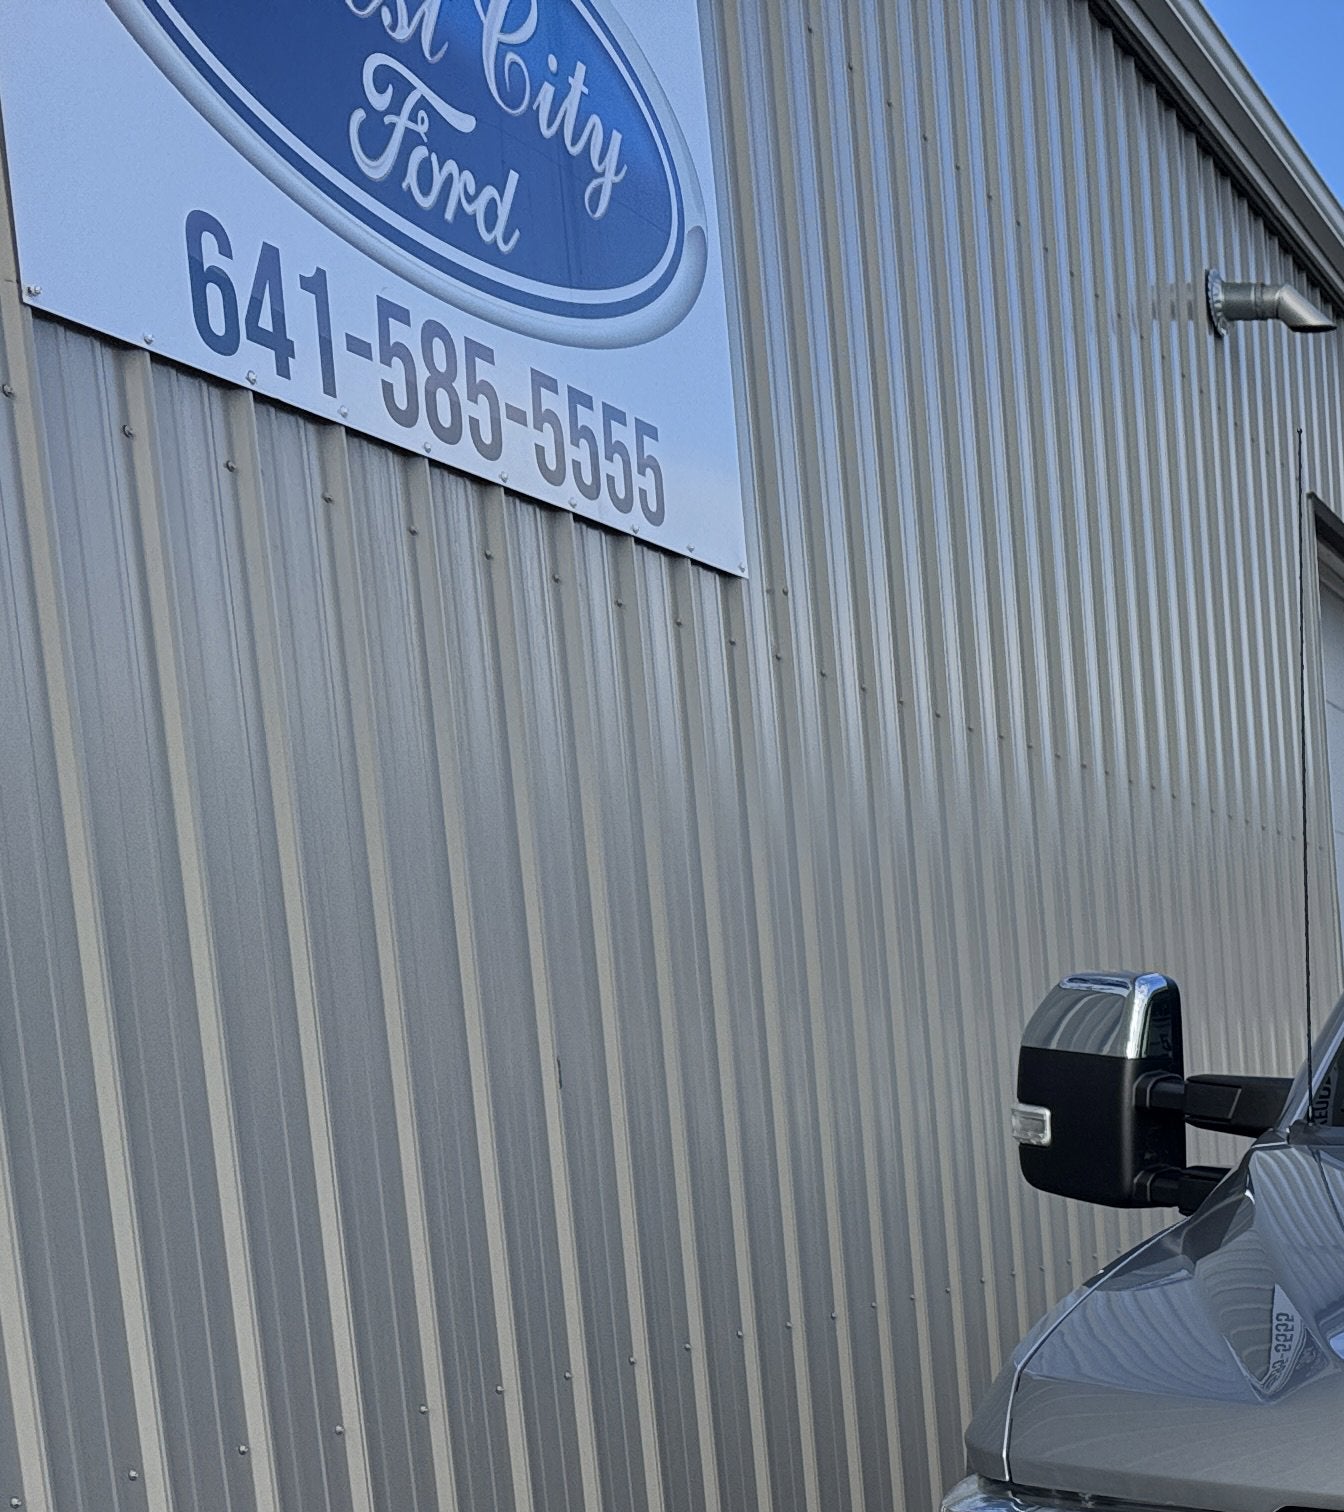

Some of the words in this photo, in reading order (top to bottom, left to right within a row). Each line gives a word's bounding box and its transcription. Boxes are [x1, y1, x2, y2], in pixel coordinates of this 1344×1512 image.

[350, 53, 520, 254] Ford
[474, 0, 628, 220] City
[185, 210, 665, 528] 641-585-5555
